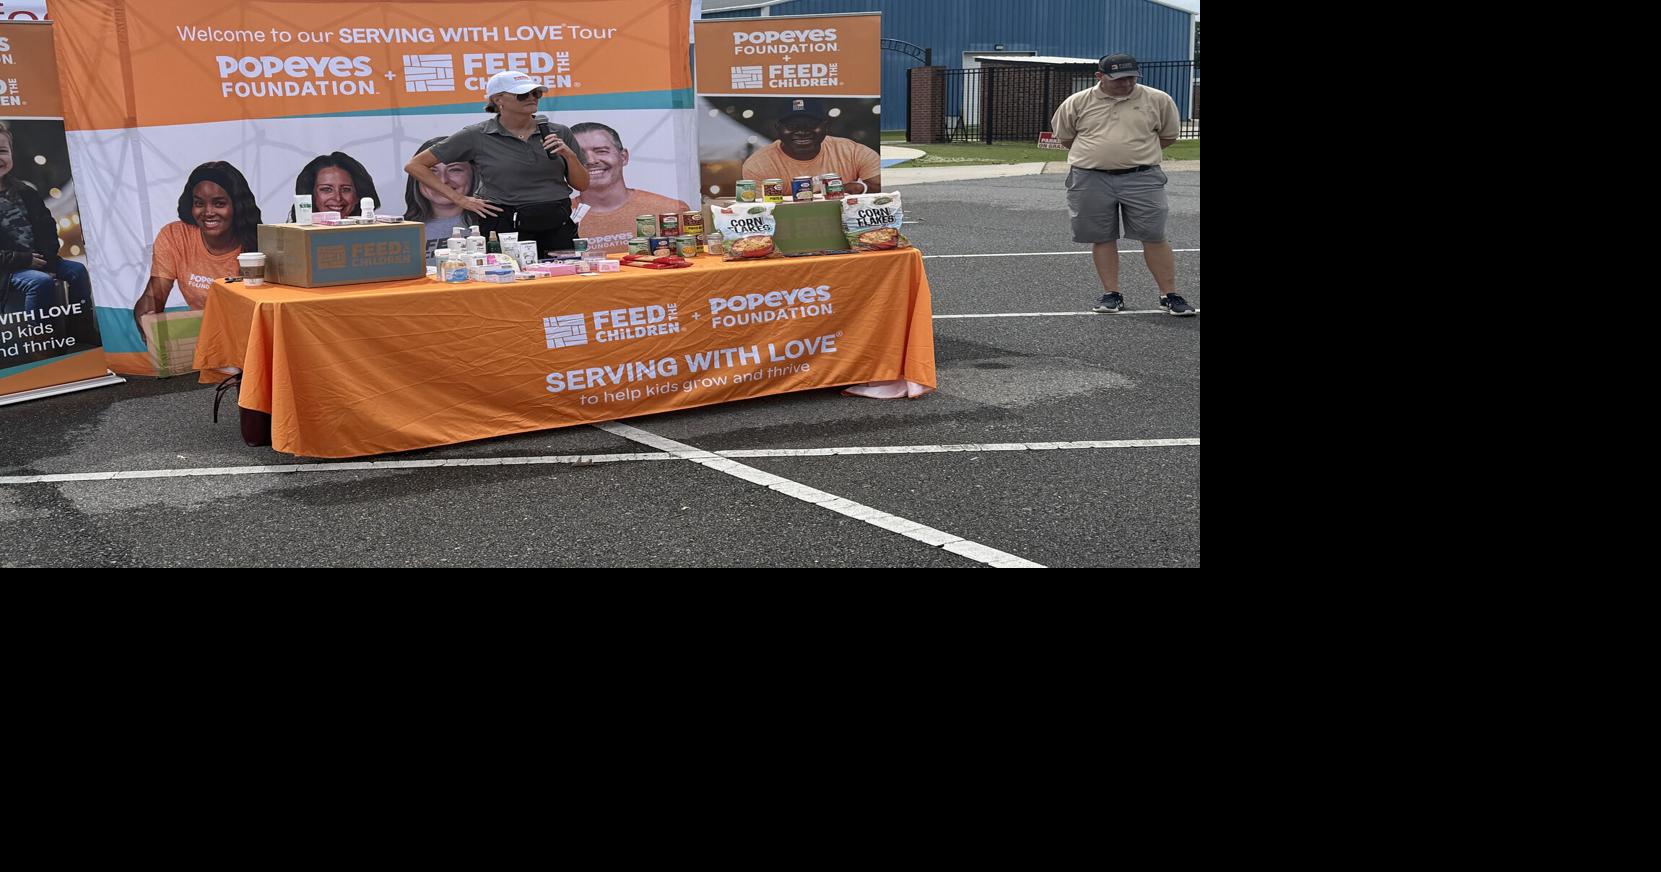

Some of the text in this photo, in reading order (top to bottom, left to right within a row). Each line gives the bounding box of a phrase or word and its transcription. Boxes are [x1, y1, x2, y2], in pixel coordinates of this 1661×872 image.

[176, 25, 265, 42] Welcome
[270, 28, 292, 43] to
[297, 31, 334, 43] our
[339, 27, 434, 44] SERVING
[439, 26, 499, 43] WITH
[567, 25, 616, 39] Tour
[734, 42, 838, 55] FOUNDATION
[463, 51, 555, 76] FEED
[556, 51, 570, 74] THE
[768, 63, 828, 79] FEED
[829, 62, 838, 77] THE
[222, 80, 375, 98] FOUNDATION
[464, 75, 572, 91] CHREN
[730, 216, 764, 228] CORN
[856, 214, 896, 227] FLAKES
[857, 207, 890, 219] CORN
[592, 304, 666, 330] FEED
[667, 302, 678, 321] THE
[712, 303, 833, 329] FOUNDATION
[17, 322, 54, 338] kids
[22, 336, 76, 354] thrive
[546, 357, 678, 393] SERVING
[684, 344, 761, 373] WITH
[580, 361, 810, 406] to help kids grow and thrive
